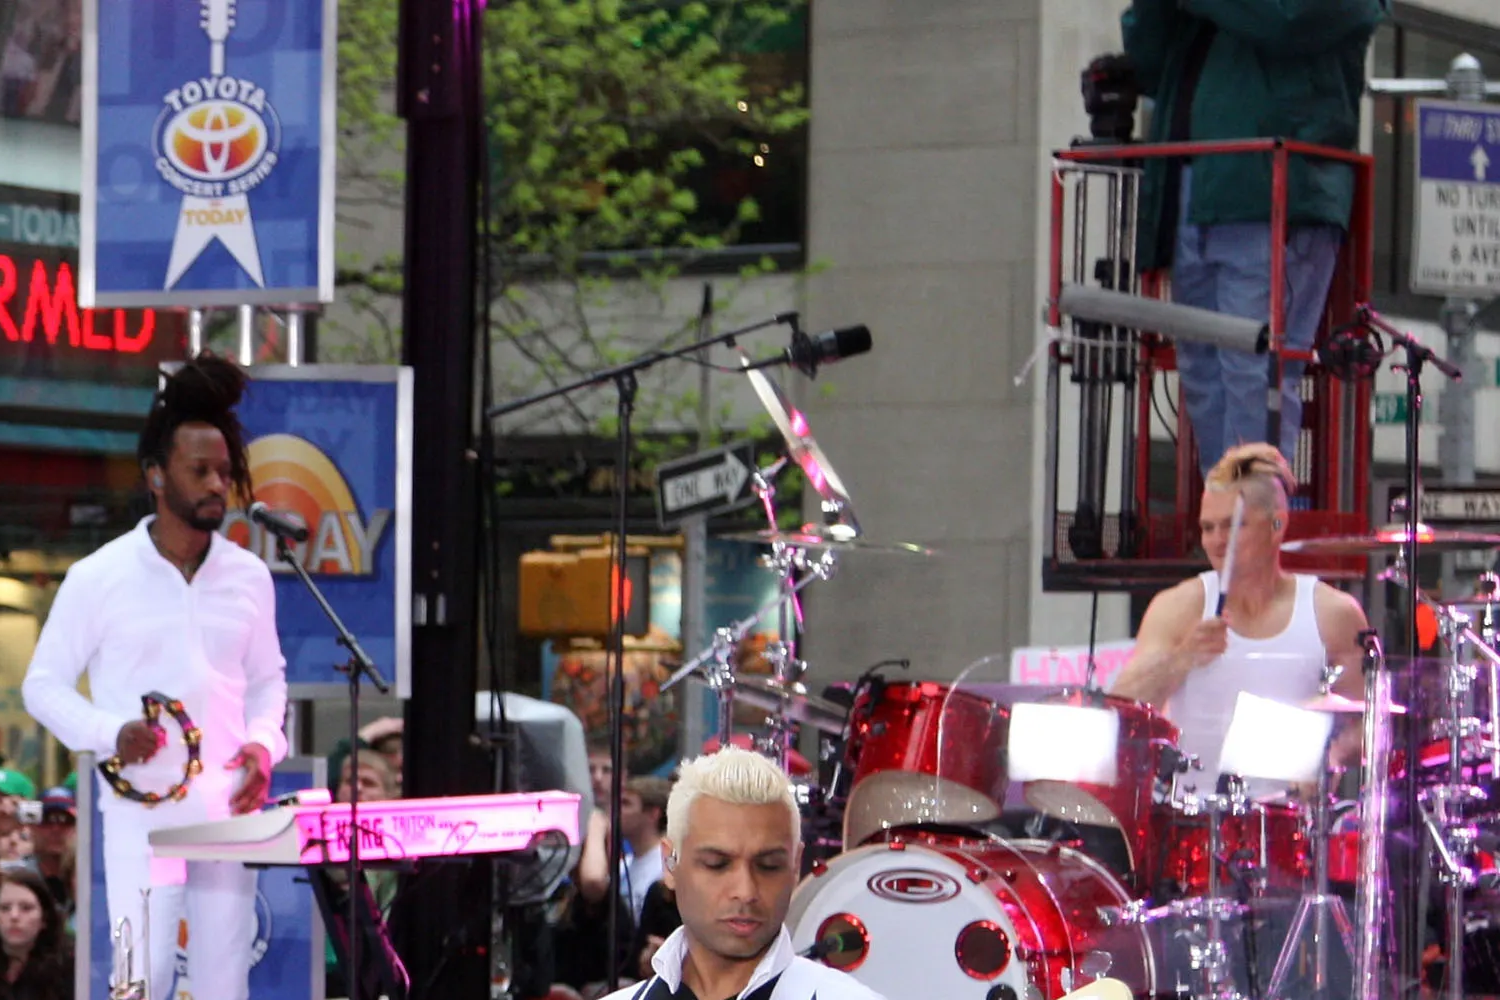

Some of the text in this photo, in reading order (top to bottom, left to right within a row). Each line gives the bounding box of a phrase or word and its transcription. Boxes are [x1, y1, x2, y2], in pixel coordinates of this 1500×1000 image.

[164, 76, 266, 113] TOYOTA
[1467, 185, 1500, 210] TUR
[11, 204, 80, 247] TODA
[183, 208, 246, 228] TODAY
[674, 476, 698, 503] ONE
[1420, 499, 1440, 515] NE
[218, 508, 390, 575] ODAY
[337, 817, 383, 850] KRG
